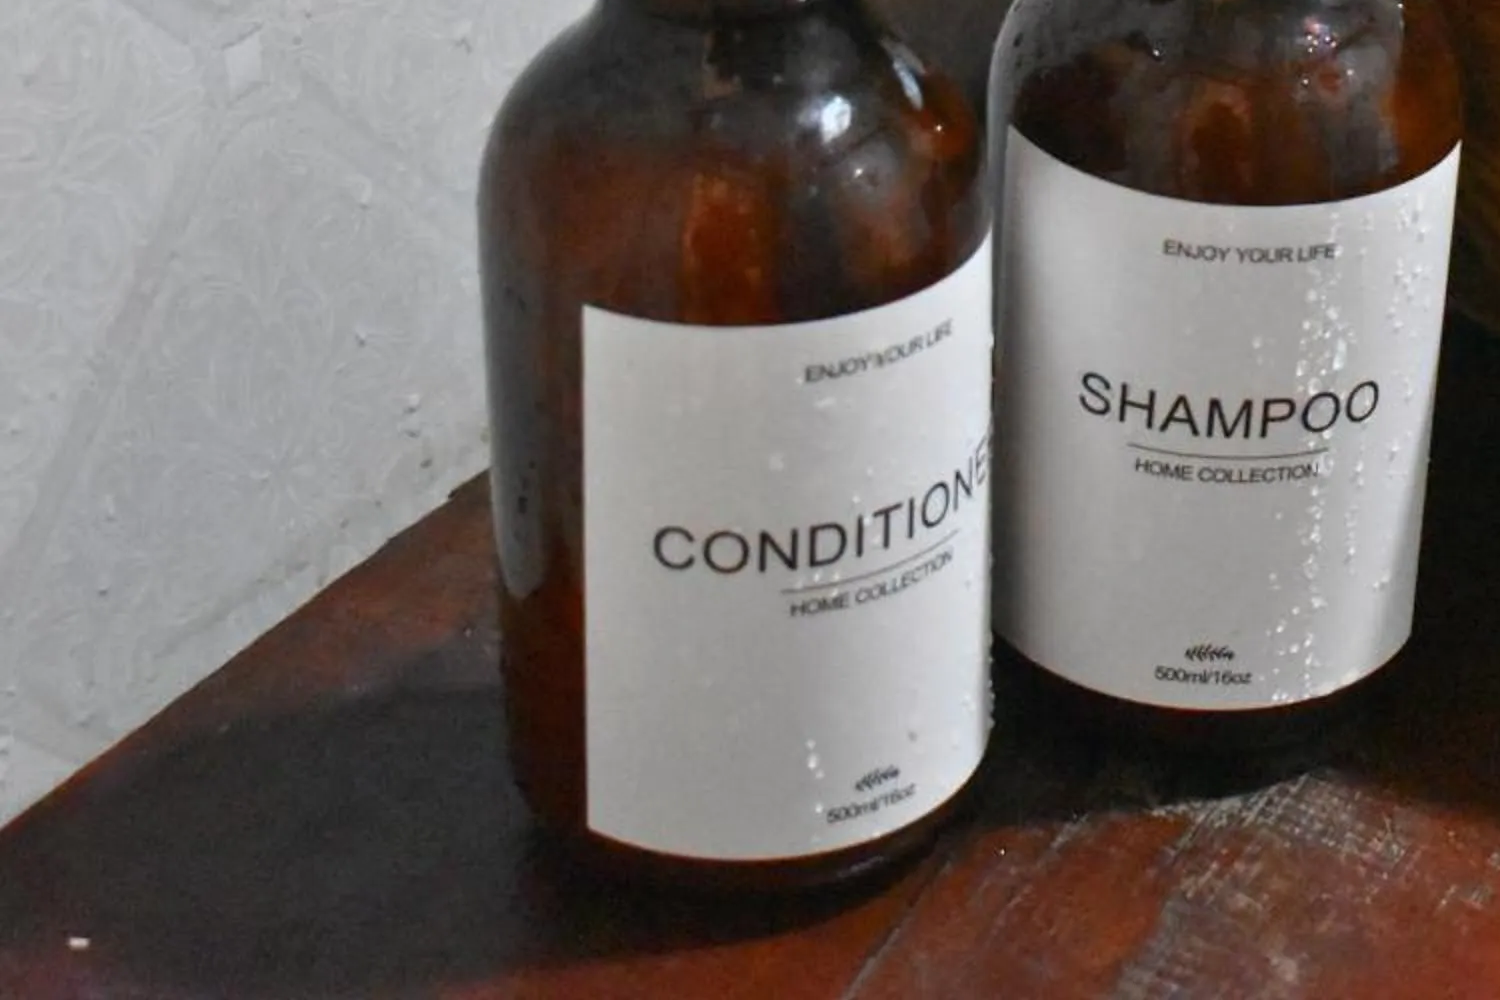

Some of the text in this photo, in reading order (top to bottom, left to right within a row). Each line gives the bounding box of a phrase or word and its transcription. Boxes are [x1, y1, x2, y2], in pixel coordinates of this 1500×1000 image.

[1163, 238, 1337, 263] ENJOY YOUR LIFE
[804, 354, 870, 382] ENJOY
[1078, 371, 1379, 439] SHAMPOO
[1135, 457, 1321, 483] HOME COLLECTION
[652, 433, 988, 574] CONDITIONE
[790, 547, 953, 617] HOME COLLECTION
[1154, 665, 1253, 685] 500ml/16oz
